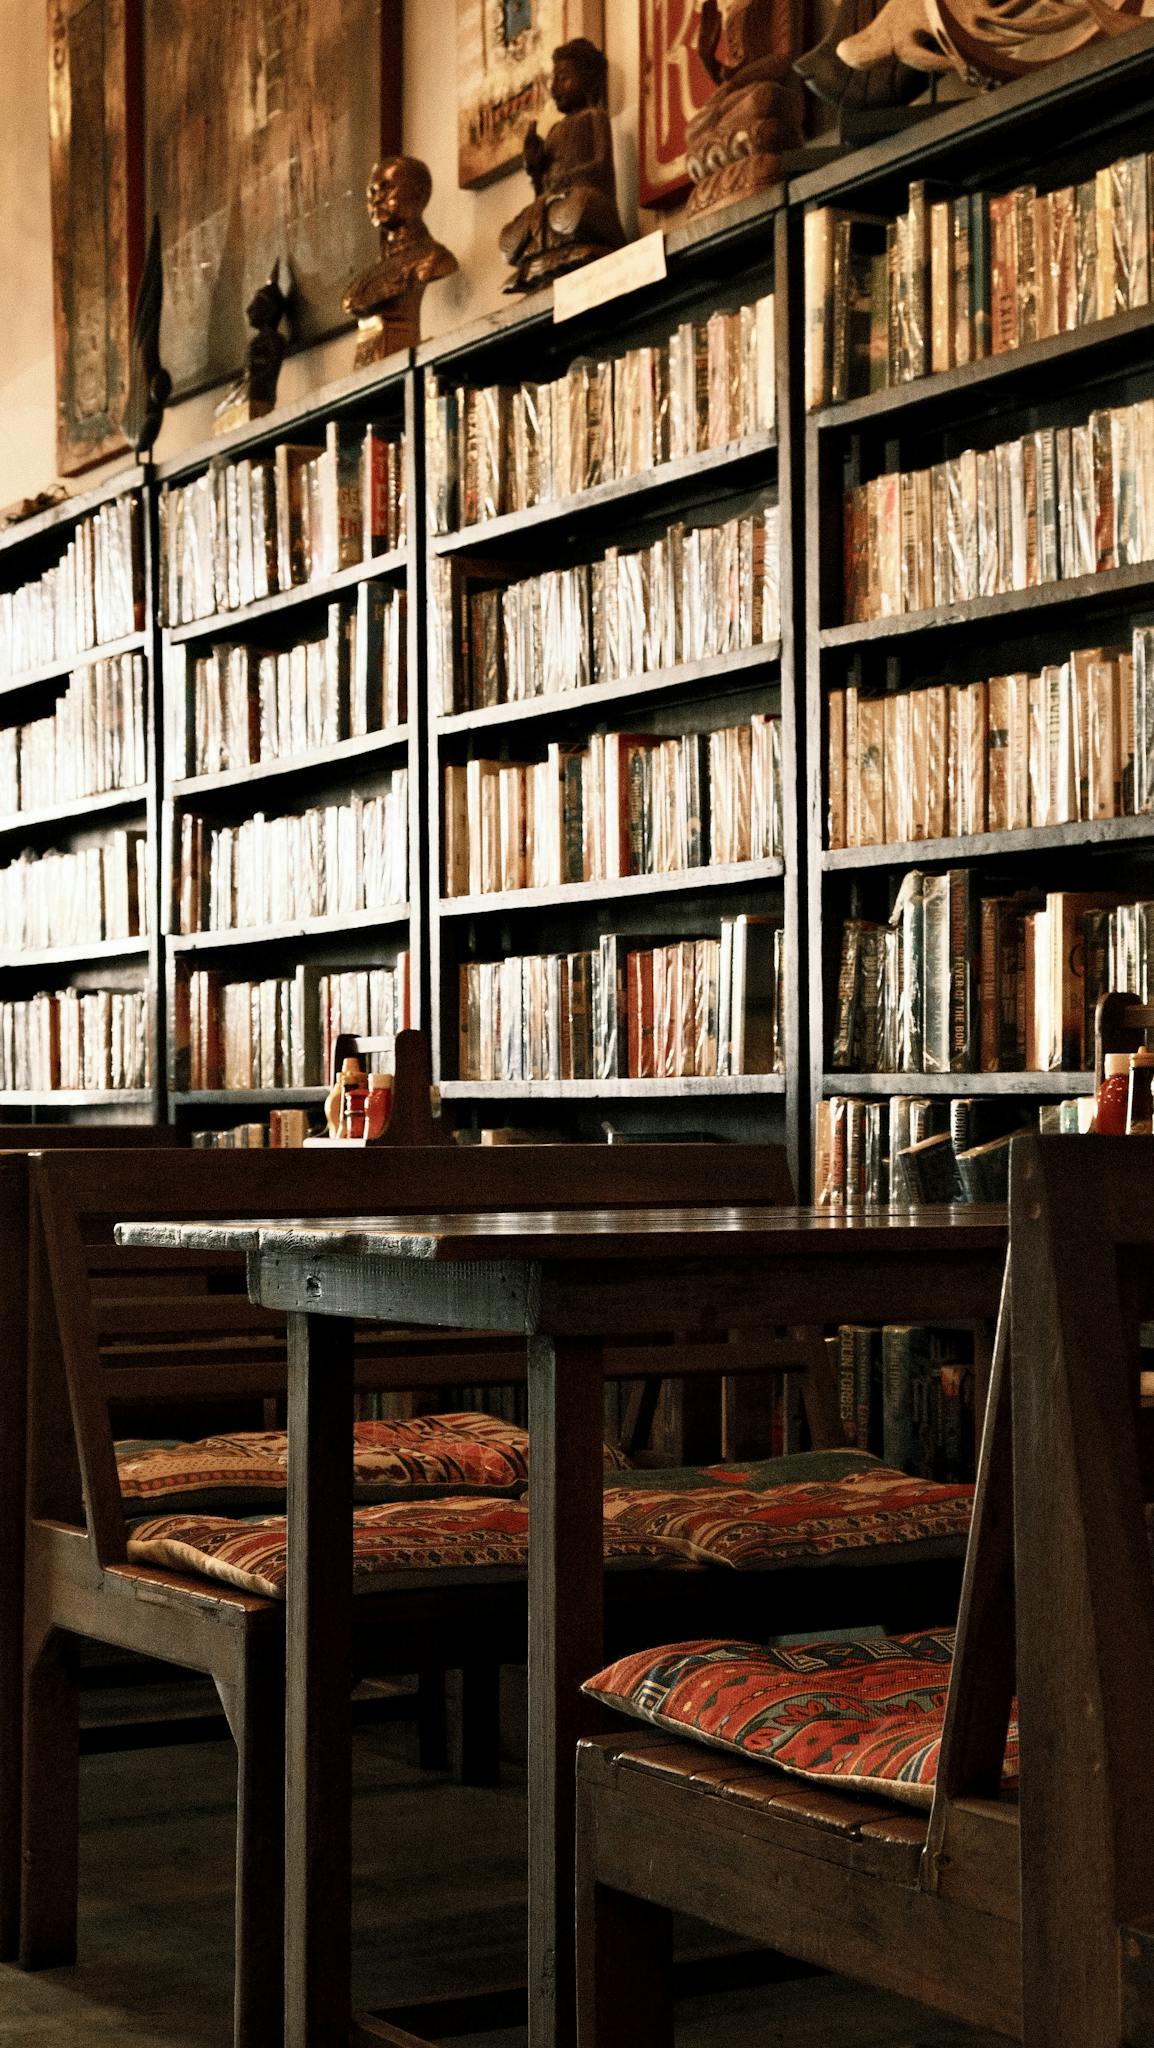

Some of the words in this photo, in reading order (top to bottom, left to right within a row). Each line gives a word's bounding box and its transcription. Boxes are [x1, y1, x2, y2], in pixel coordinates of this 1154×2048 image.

[954, 956, 965, 988] FEVER
[954, 989, 965, 1002] OF
[954, 1004, 965, 1023] THE
[954, 1025, 965, 1051] BONE
[840, 1371, 854, 1419] FORBES
